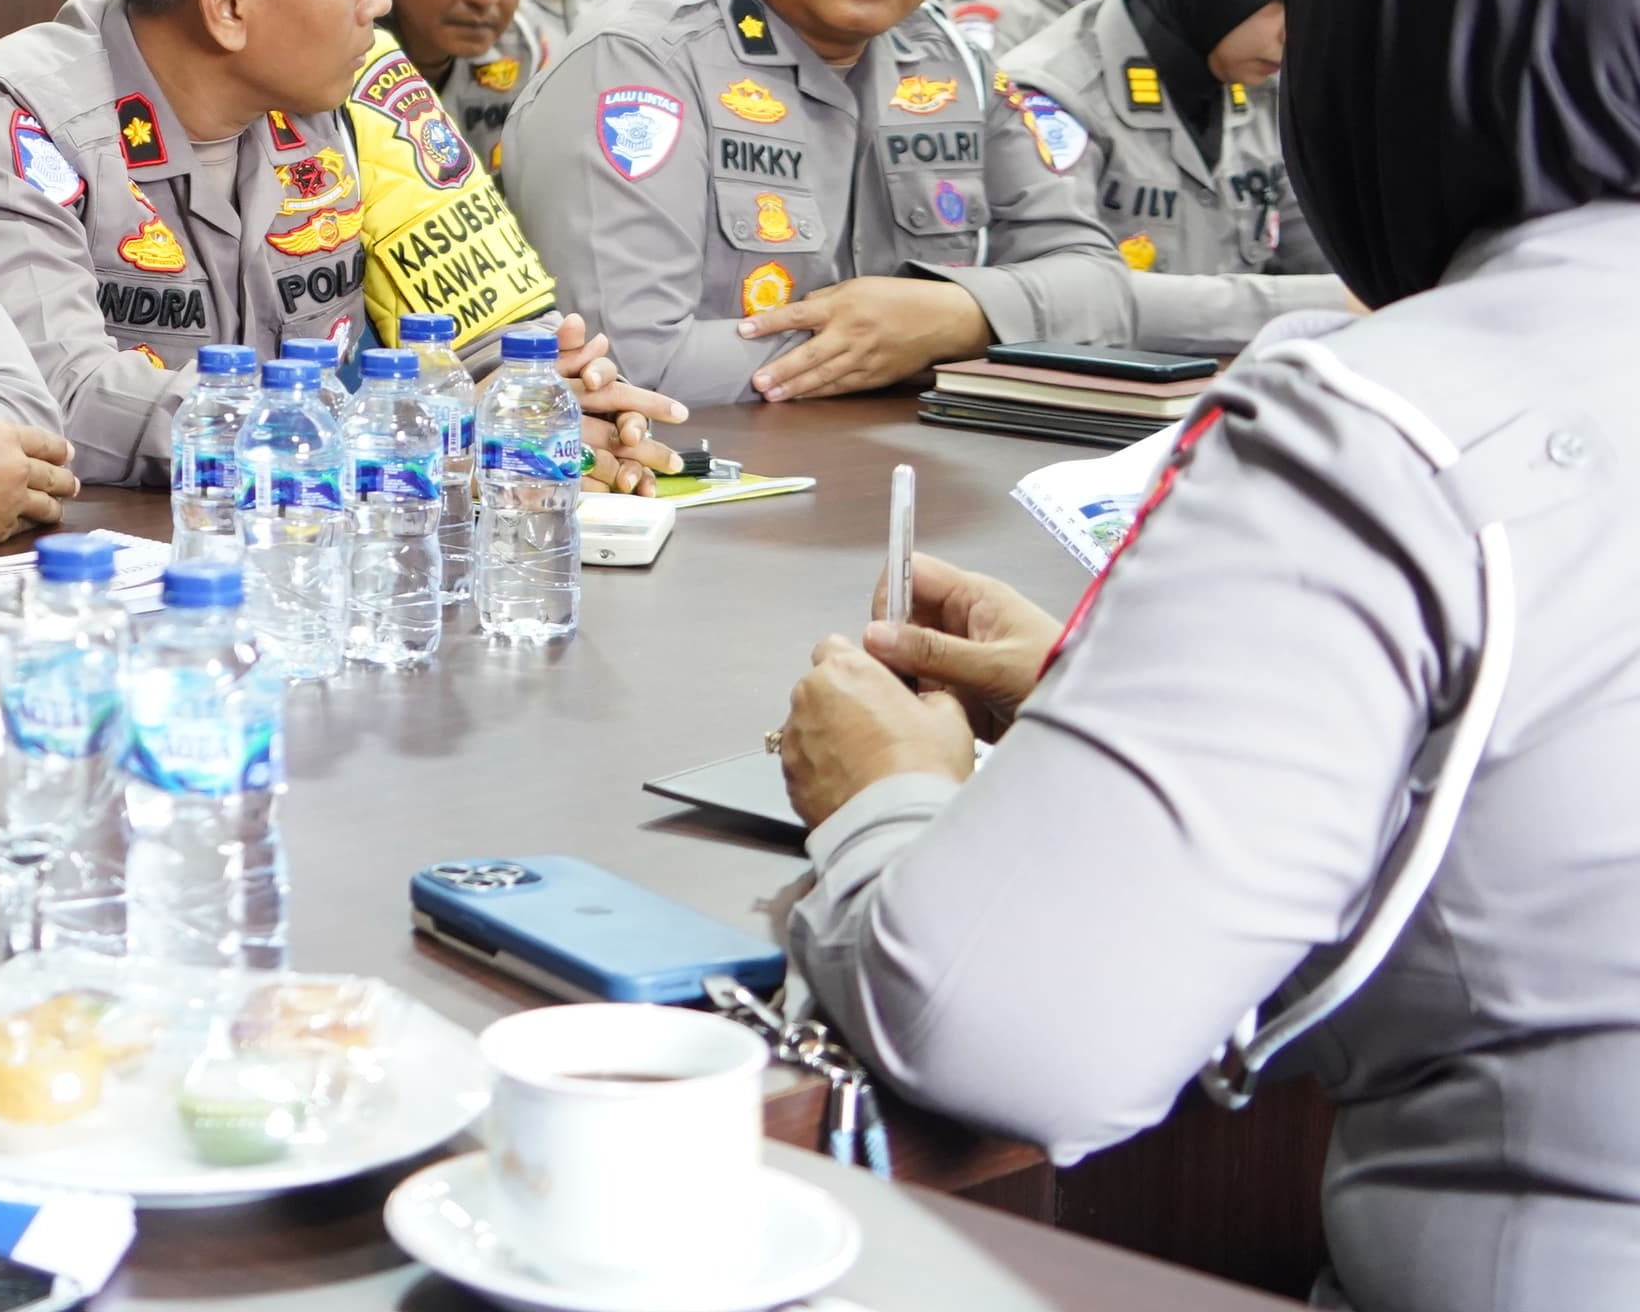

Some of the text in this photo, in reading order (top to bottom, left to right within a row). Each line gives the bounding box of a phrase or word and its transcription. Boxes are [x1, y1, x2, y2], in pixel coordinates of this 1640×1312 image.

[368, 62, 420, 101] POLDA
[396, 89, 428, 112] RIAU
[604, 90, 679, 114] LALU LINTAS
[720, 137, 802, 180] RIKKY
[886, 131, 979, 165] POLRI
[413, 238, 507, 314] KAWAL
